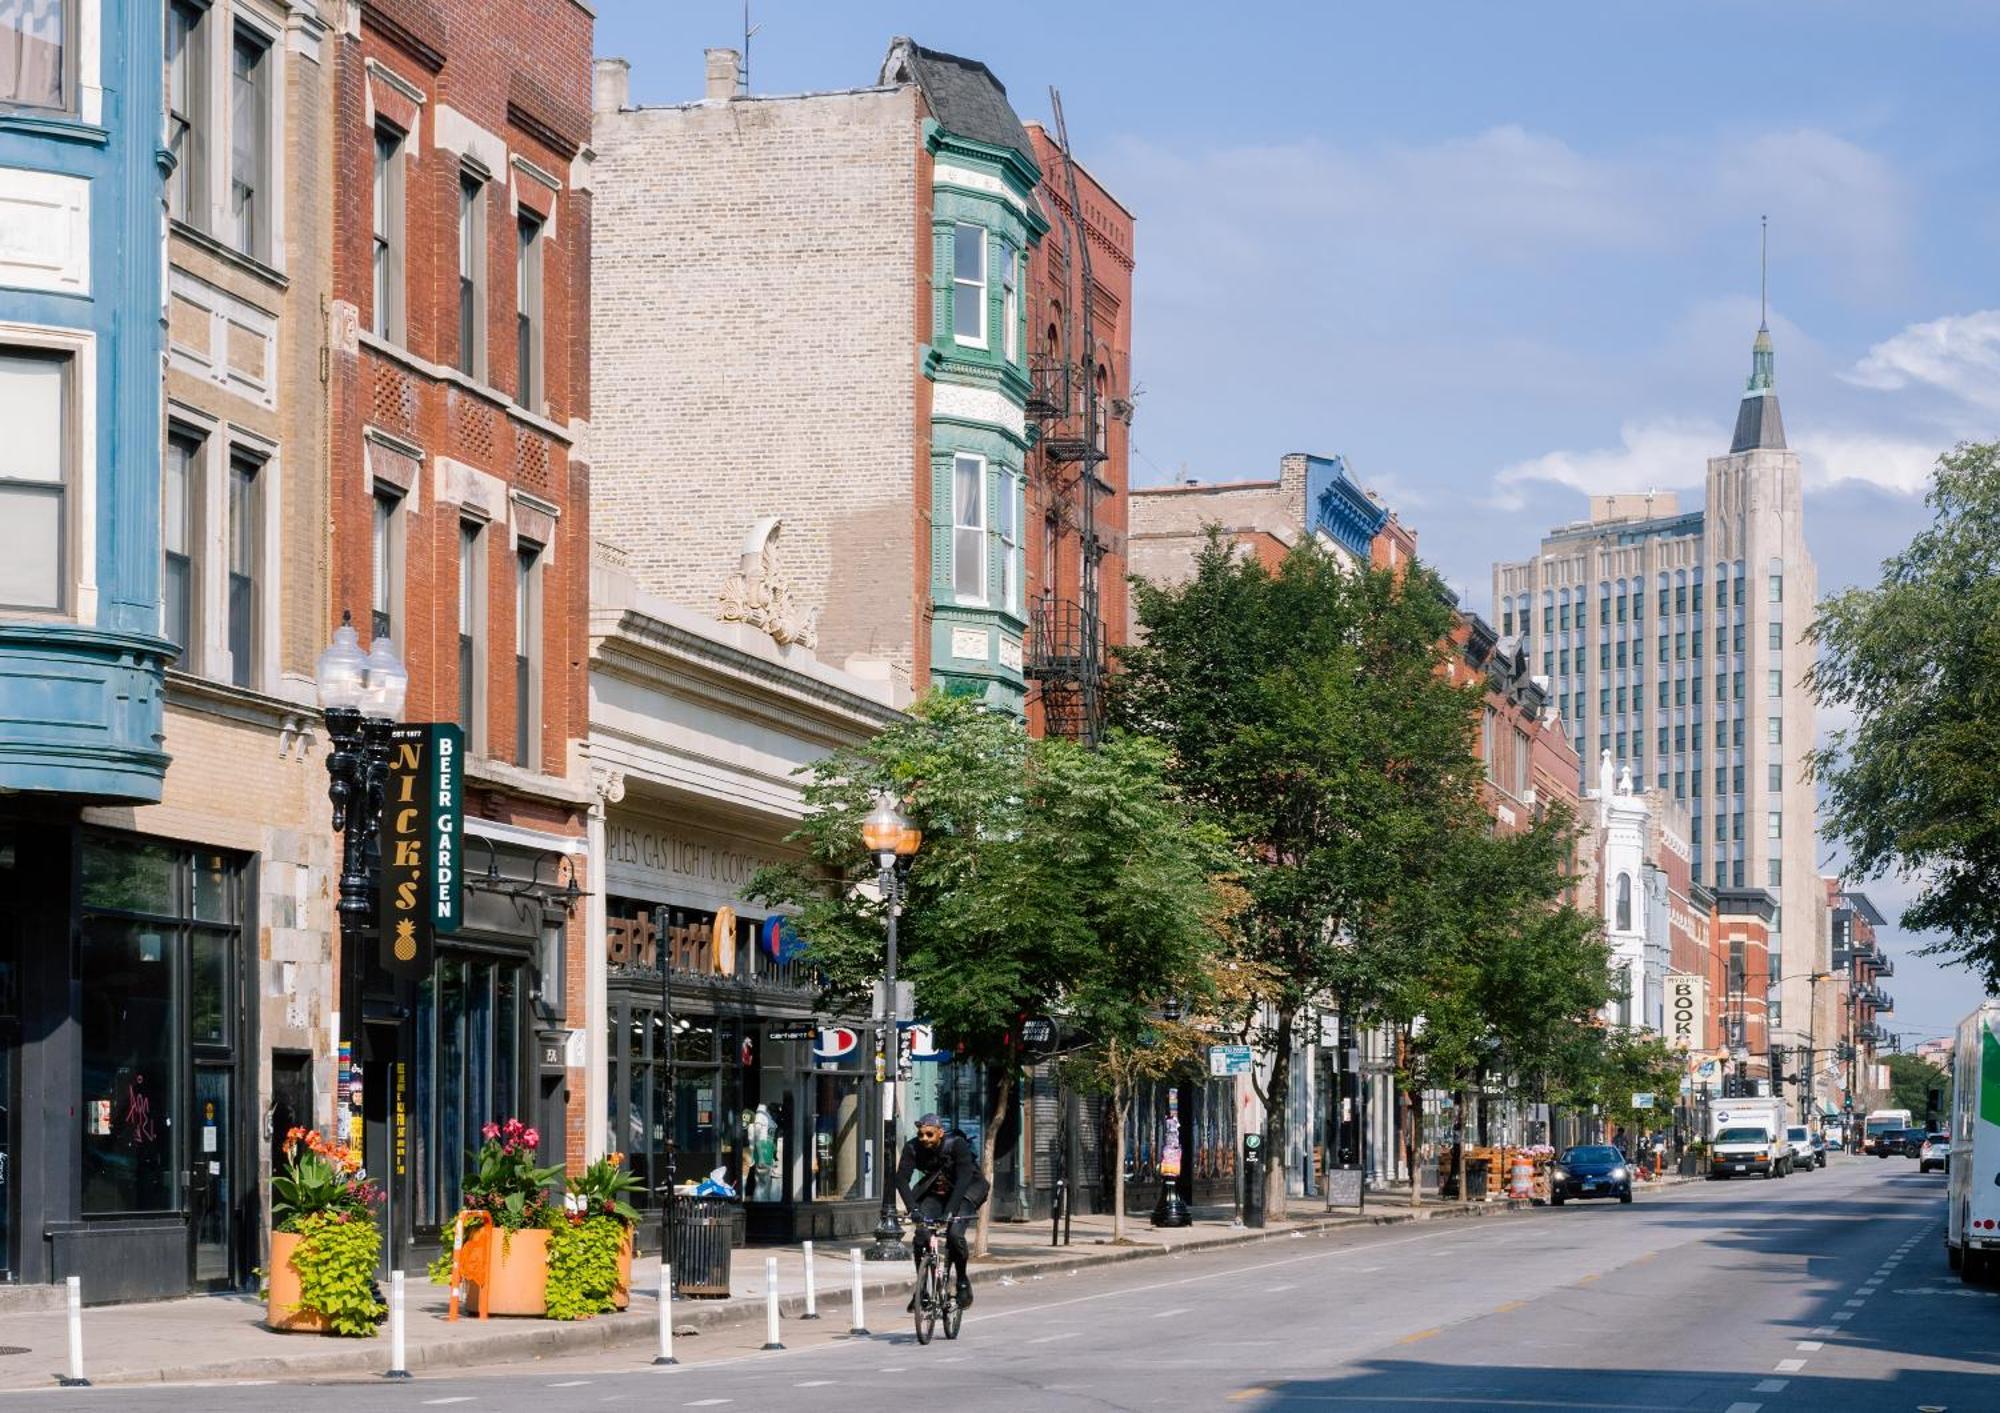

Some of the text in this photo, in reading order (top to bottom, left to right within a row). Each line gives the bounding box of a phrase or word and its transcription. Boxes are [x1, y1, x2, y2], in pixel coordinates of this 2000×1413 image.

[389, 743, 424, 910] NICK'S
[437, 737, 453, 918] BEER GARDEN
[643, 833, 668, 871] GAS
[672, 839, 706, 879] LIGHT
[721, 850, 752, 886] COKE
[1668, 976, 1700, 984] MYOPIC
